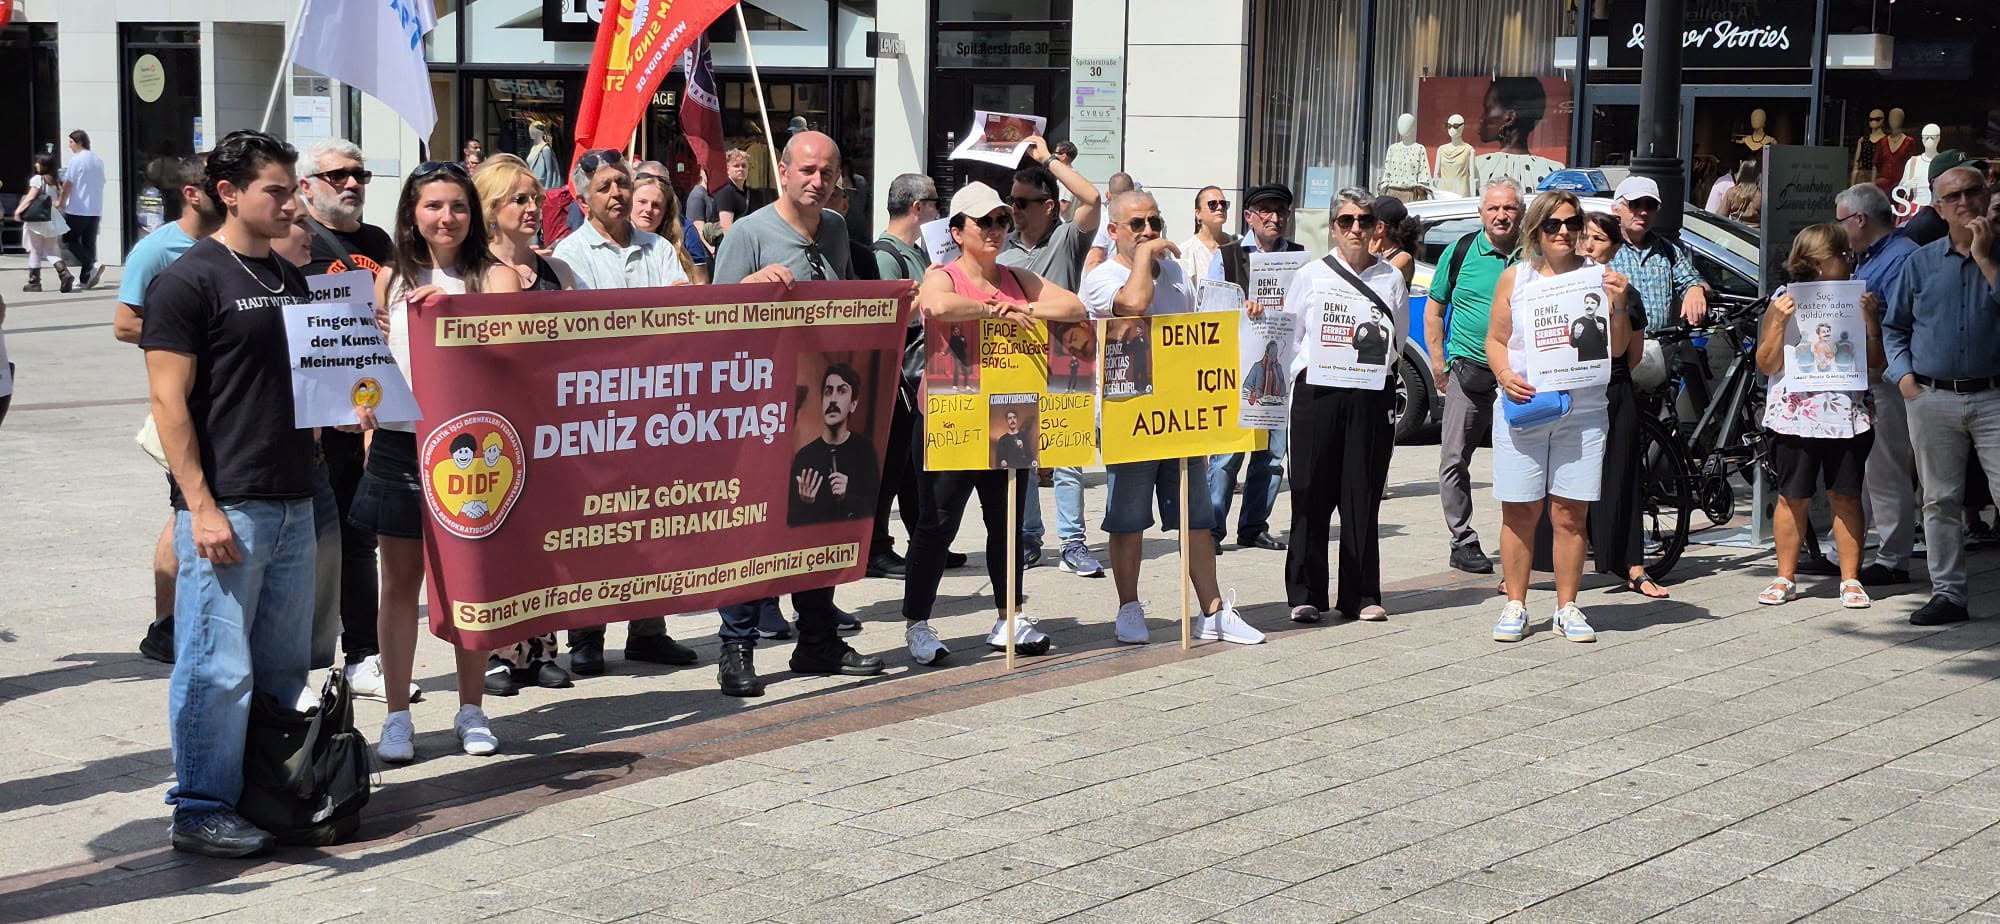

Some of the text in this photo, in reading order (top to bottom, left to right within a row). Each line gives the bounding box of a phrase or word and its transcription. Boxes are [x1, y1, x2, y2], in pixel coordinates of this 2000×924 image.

[1713, 20, 1790, 50] Stories
[1034, 42, 1048, 55] 30
[1089, 66, 1102, 77] 30
[235, 296, 270, 312] HAUT
[308, 288, 330, 301] OCH
[333, 286, 351, 298] DIE
[1797, 301, 1854, 310] Kasten adam
[307, 316, 357, 331] Finger
[443, 300, 893, 343] Finger weg von der Kunst- und Meinungsfreiheit!
[983, 320, 1018, 338] İFADE
[310, 335, 338, 347] der
[1162, 322, 1220, 346] DENİZ
[557, 351, 774, 407] FREIHEIT FÜR
[928, 395, 975, 415] DENİZ
[534, 402, 787, 459] DENİZ GÖKTAŞ!
[1132, 405, 1228, 436] ADALET
[926, 428, 982, 450] ADALET
[447, 471, 501, 495] DIDF
[583, 478, 741, 516] DENİZ GÖKTAŞ
[543, 501, 768, 552] SERBEST BIRAKILSIN!
[459, 544, 855, 624] Sanat ve ifade özgürlüğünden ellerinizi çekin!
